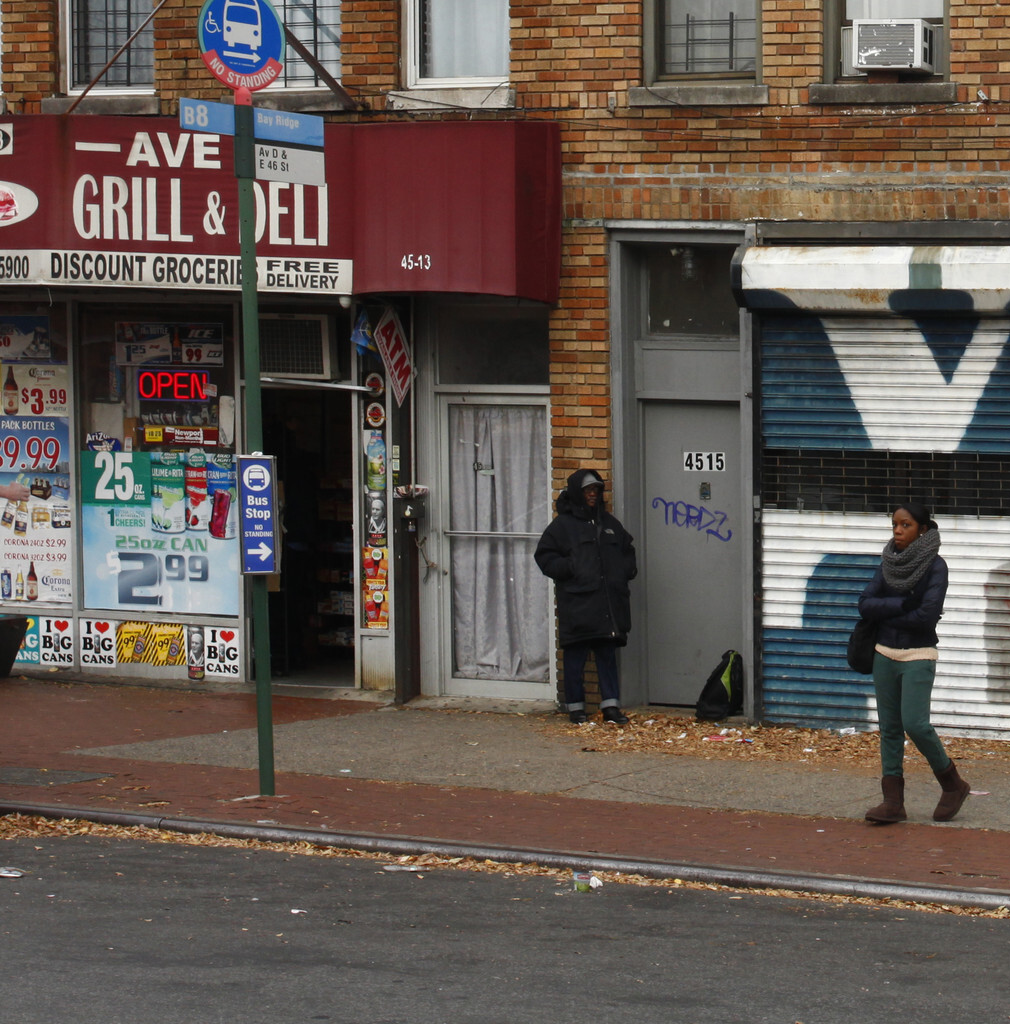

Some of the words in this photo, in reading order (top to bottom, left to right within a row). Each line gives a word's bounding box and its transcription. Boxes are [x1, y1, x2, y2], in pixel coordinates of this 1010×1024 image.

[210, 58, 225, 75] NO
[226, 65, 277, 88] STANDING
[184, 105, 208, 126] B8
[257, 113, 273, 127] Bay
[275, 115, 299, 129] Ridge
[259, 147, 269, 157] Av
[273, 148, 278, 158] D
[281, 150, 287, 159] &
[260, 160, 264, 169] E
[267, 160, 277, 171] 46
[281, 163, 289, 172] St
[73, 174, 193, 242] GRILL
[203, 191, 225, 235] &
[266, 260, 339, 274] FREE
[401, 254, 431, 270] 45-13
[50, 253, 146, 282] DISCOUNT
[152, 256, 258, 285] GROCERIE
[266, 274, 339, 290] DELIVERY
[381, 320, 412, 392] ATM
[138, 372, 208, 400] OPEN
[21, 387, 67, 415] $3.99
[1, 420, 20, 430] PACK
[22, 421, 55, 431] BOTTLES
[0, 435, 61, 470] 9.99
[685, 453, 724, 470] 4515
[94, 450, 135, 501] 25
[134, 484, 145, 494] OZ.
[247, 495, 268, 506] Bus
[245, 508, 271, 521] Stop
[115, 518, 146, 527] CHEERS!
[4, 538, 29, 546] CORONA
[45, 538, 67, 548] $2.99
[170, 536, 208, 553] CAN
[4, 552, 29, 561] CORONA
[45, 552, 67, 562] $3.99
[41, 575, 71, 586] Corona
[46, 620, 51, 632] I
[86, 621, 92, 634] I
[211, 630, 217, 643] I
[42, 653, 73, 663] CANS
[82, 655, 114, 665] CANS
[207, 663, 239, 674] CANS
